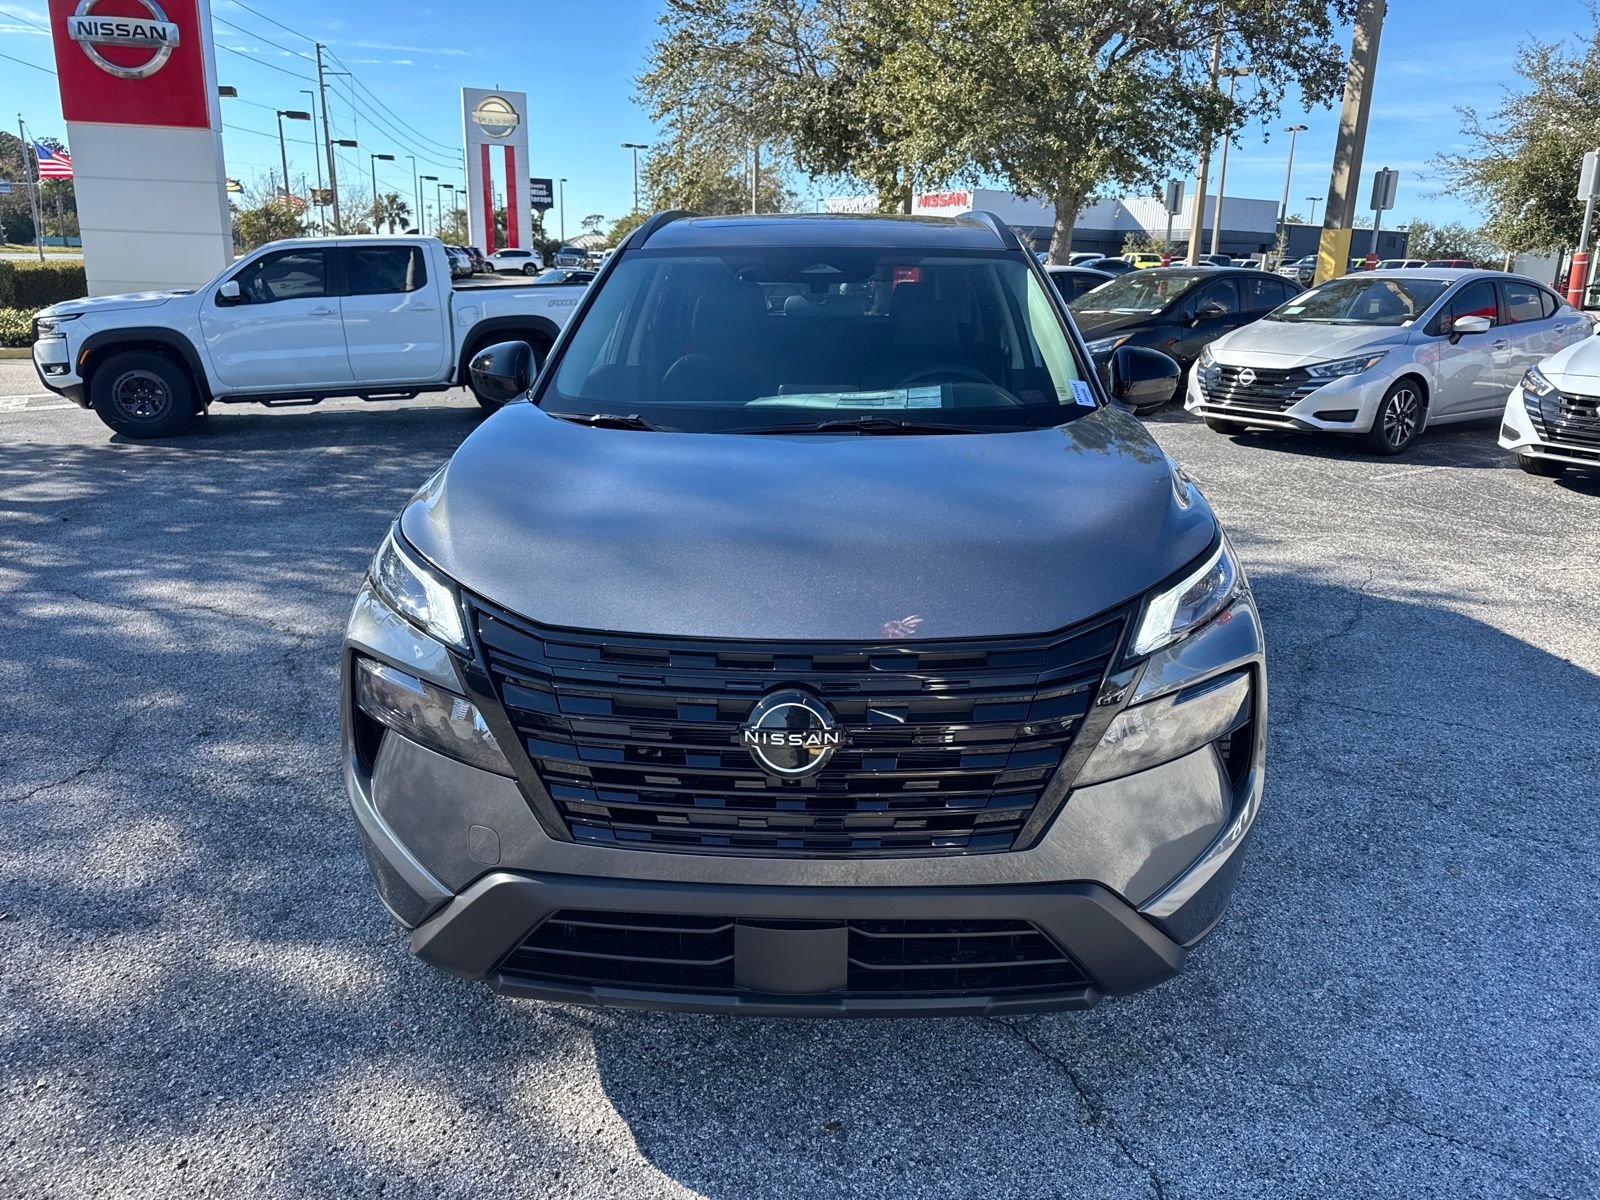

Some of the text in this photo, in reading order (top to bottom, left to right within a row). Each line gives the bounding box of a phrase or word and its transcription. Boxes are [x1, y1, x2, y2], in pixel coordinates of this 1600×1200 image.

[77, 21, 168, 41] NISSAN
[918, 193, 968, 207] NISSAN
[744, 730, 839, 746] NISSAN
